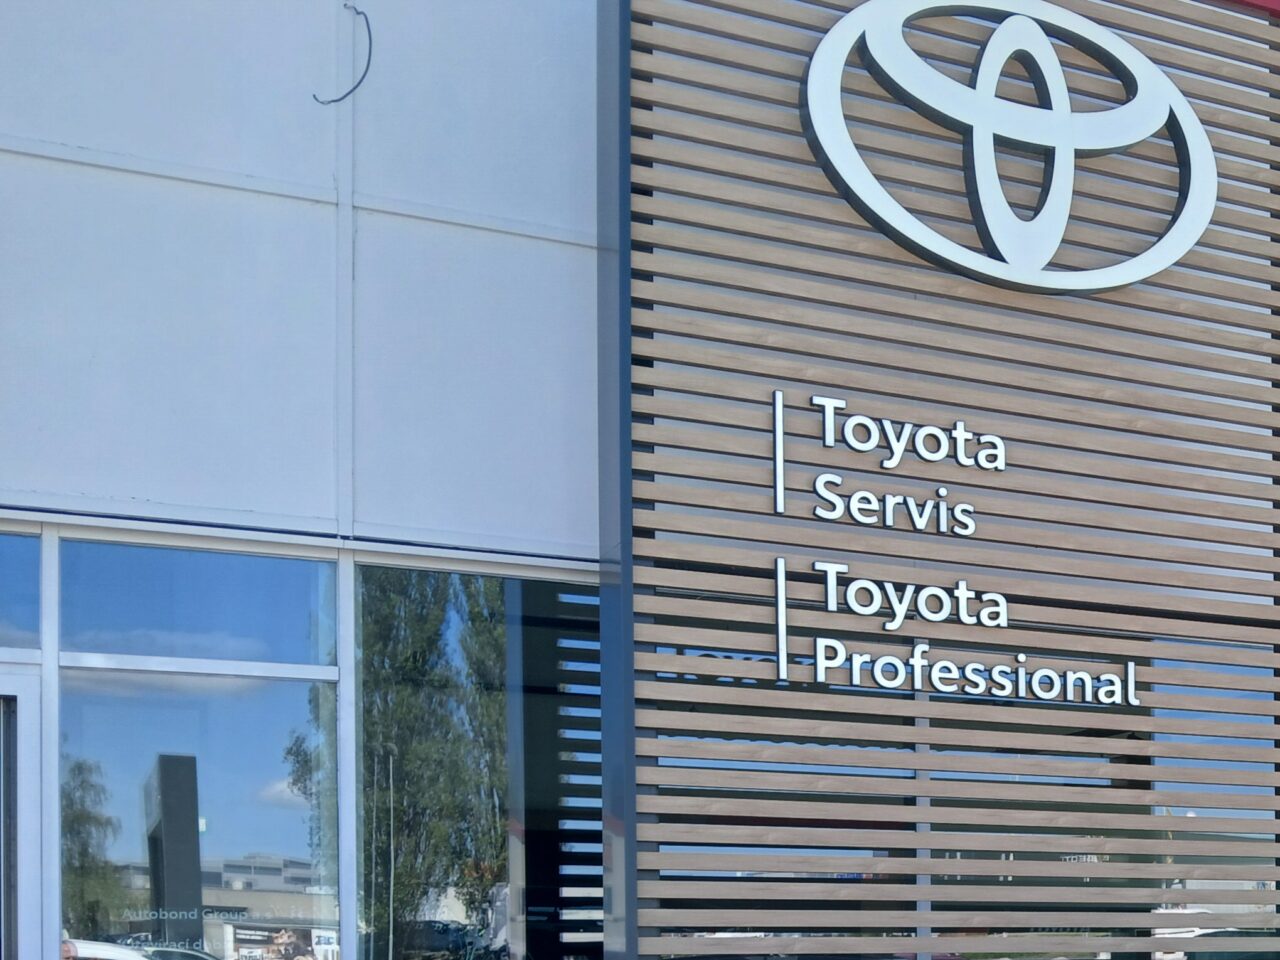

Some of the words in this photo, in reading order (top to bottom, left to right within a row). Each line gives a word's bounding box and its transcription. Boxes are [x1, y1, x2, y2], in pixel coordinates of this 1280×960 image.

[810, 394, 1007, 471] Toyota
[812, 472, 977, 537] Servis
[812, 560, 1010, 631] Toyota
[813, 636, 1142, 707] Professional
[121, 908, 199, 921] Autobond
[201, 908, 248, 922] Group
